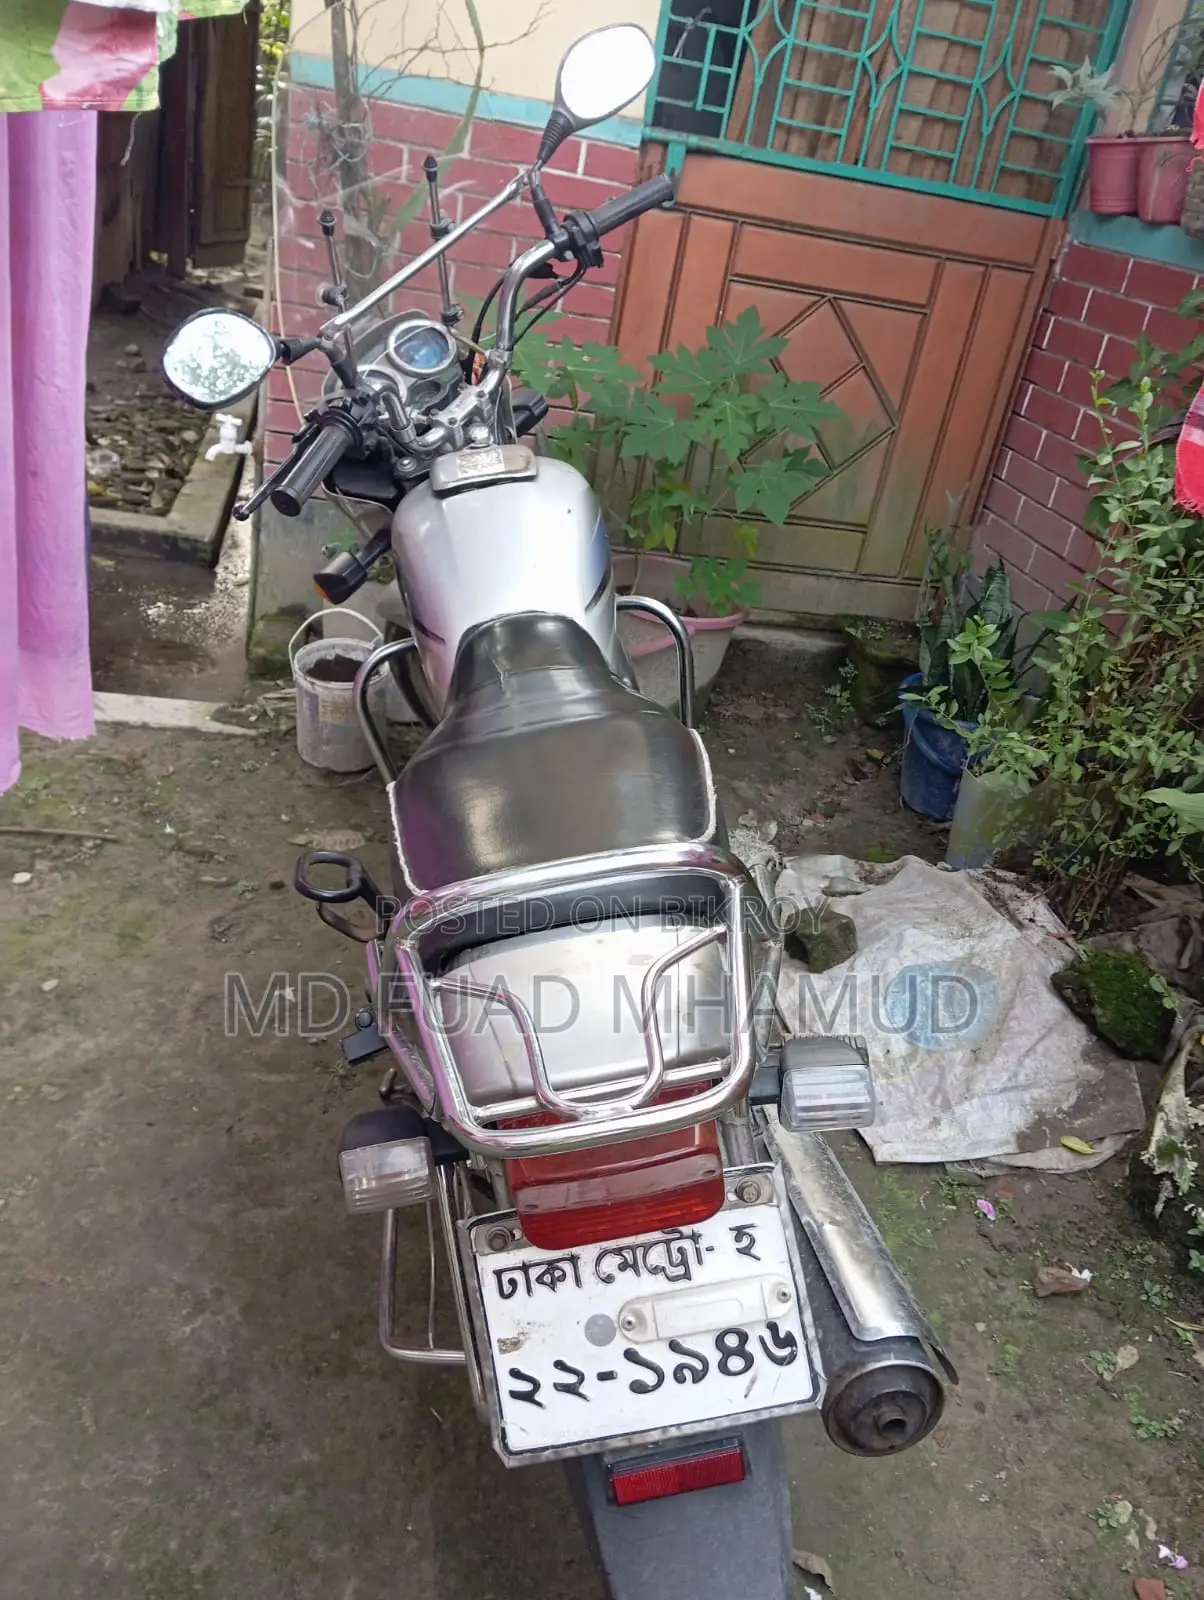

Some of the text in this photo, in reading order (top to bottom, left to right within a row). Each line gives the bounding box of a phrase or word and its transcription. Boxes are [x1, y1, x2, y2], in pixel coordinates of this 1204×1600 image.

[492, 1252, 582, 1300] ঢাকা
[729, 1223, 761, 1261] হ
[508, 1320, 798, 1410] ২২-১৯৪৬
